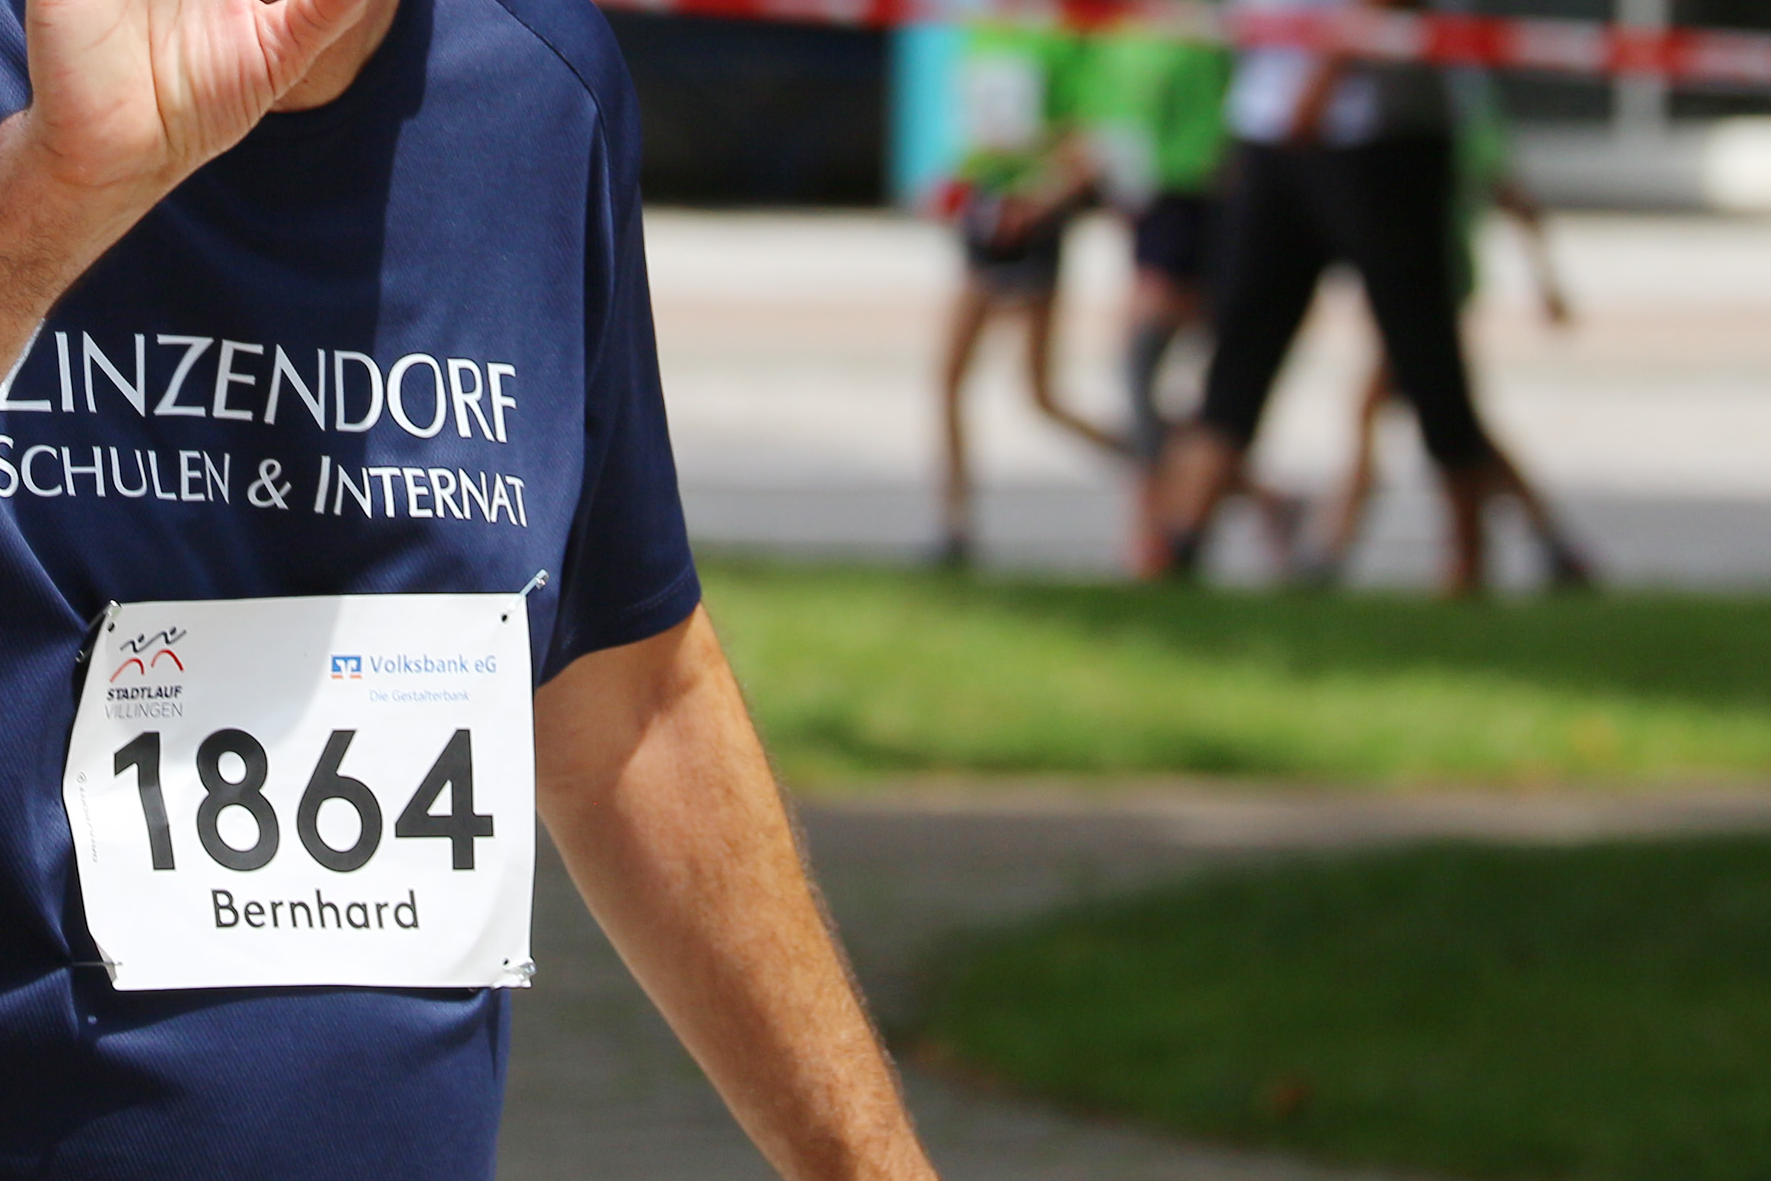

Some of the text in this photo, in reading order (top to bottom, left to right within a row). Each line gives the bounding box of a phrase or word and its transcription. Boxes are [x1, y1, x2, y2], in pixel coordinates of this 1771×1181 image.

[246, 458, 292, 509] &
[314, 455, 528, 528] INTERNAT
[369, 653, 497, 674] Volksbank eG
[107, 685, 183, 701] STADTLAUF
[105, 701, 183, 719] VILLINGEN
[114, 728, 494, 872] 1864
[211, 889, 420, 929] Bernhard
